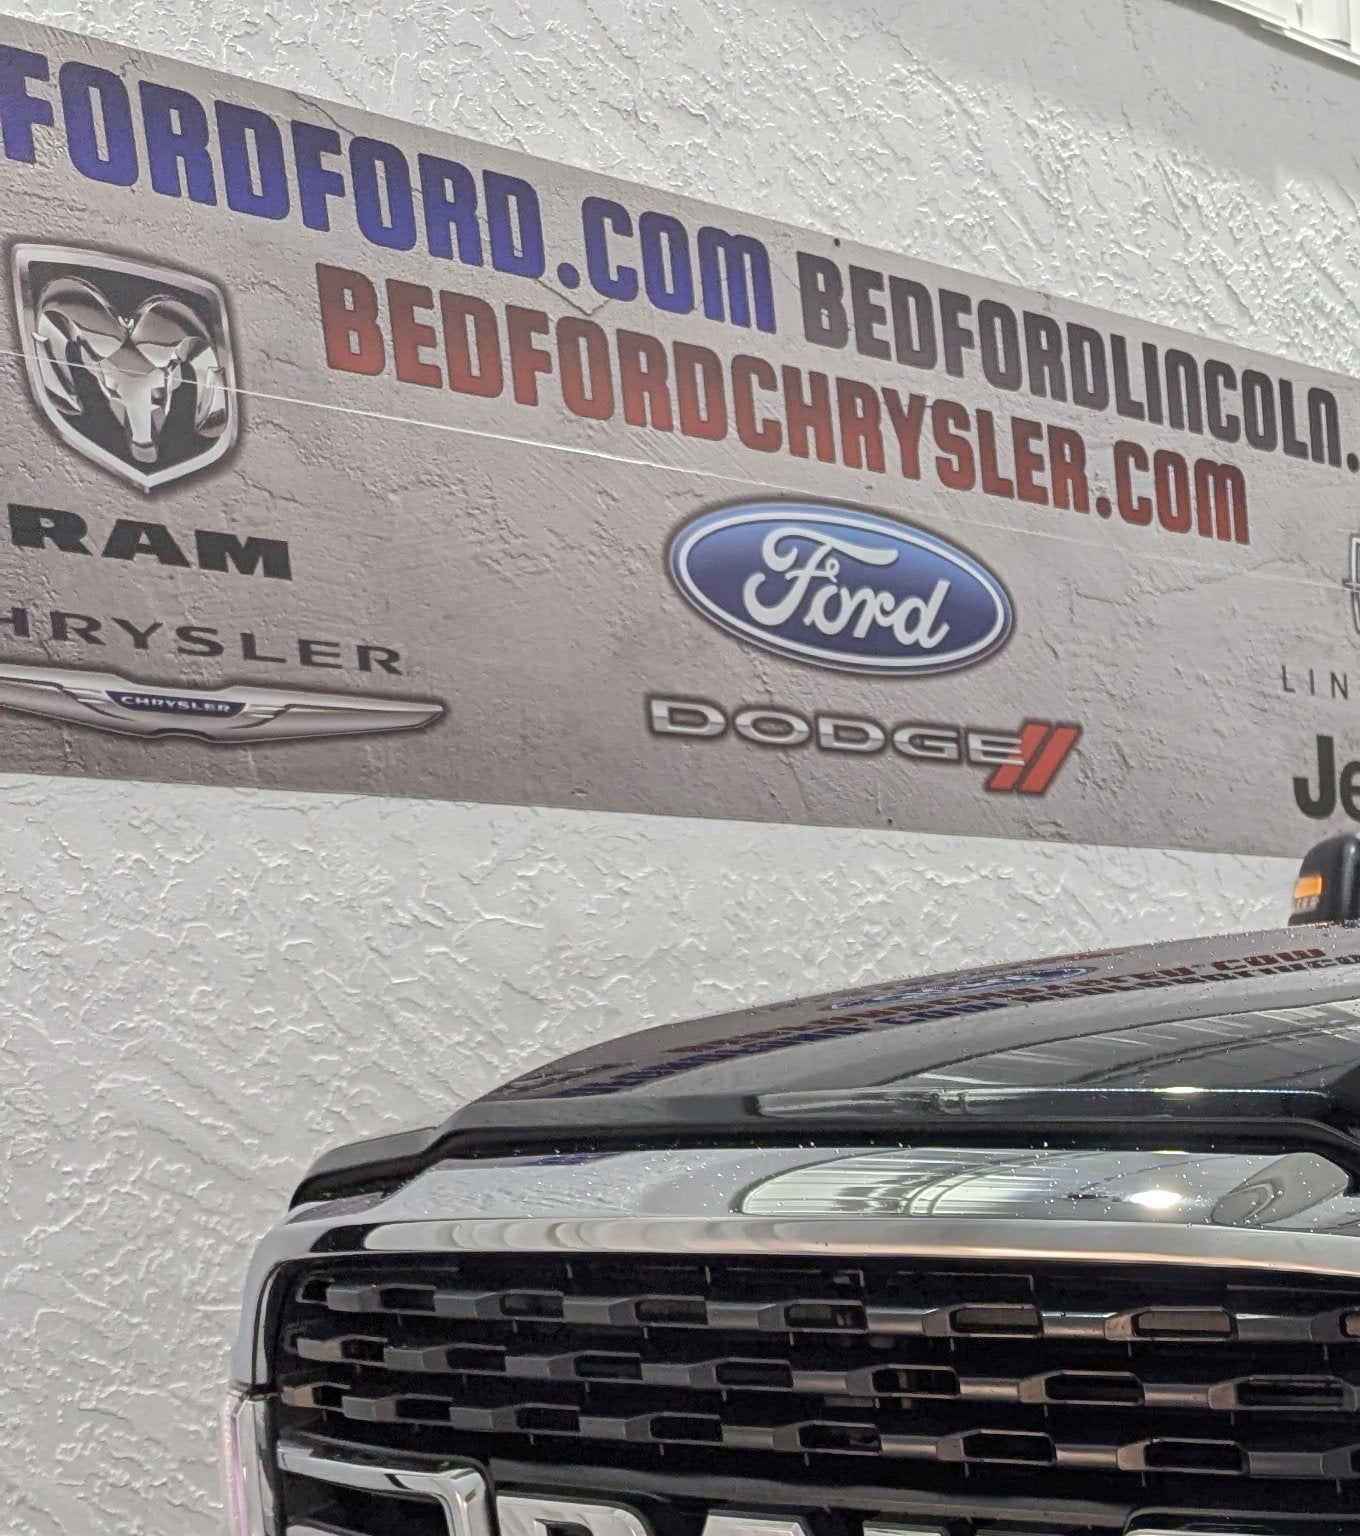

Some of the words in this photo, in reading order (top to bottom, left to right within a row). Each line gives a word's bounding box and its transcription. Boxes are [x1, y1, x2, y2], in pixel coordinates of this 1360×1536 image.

[0, 43, 777, 335] FORDFORD.COM
[315, 262, 1250, 546] BEDFORDCHRYSLER.COM
[7, 503, 293, 581] RAM
[743, 526, 952, 649] Ford
[121, 695, 231, 715] CHRYSLER
[649, 699, 1025, 767] DODGE
